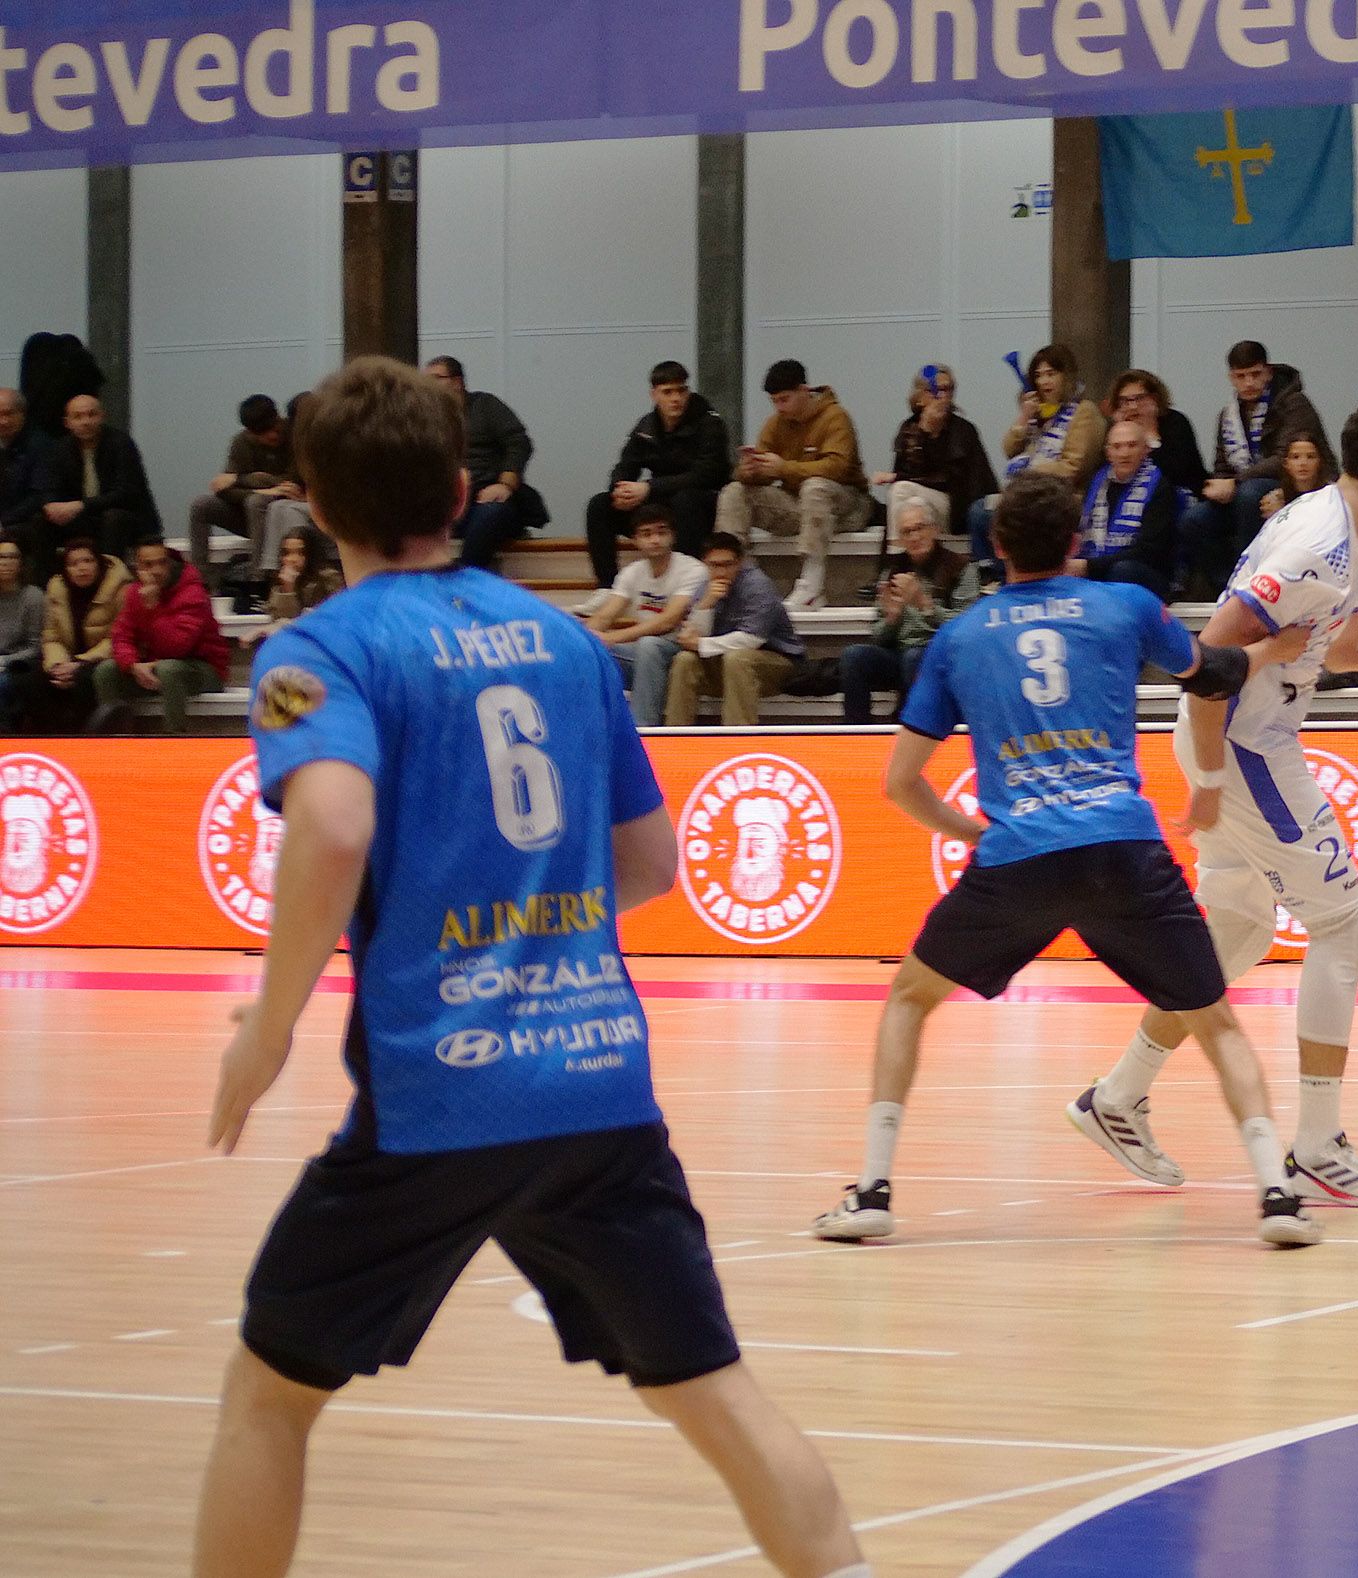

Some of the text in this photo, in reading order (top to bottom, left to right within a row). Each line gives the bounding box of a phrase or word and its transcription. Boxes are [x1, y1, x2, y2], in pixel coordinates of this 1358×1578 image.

[350, 156, 373, 186] C
[1016, 628, 1071, 706] 3
[476, 684, 563, 852] 6
[0, 764, 88, 857] DERETAS
[685, 765, 832, 861] O'PANDERETAS
[1314, 836, 1352, 883] 2
[437, 887, 607, 951] ALIMERK
[700, 881, 821, 932] TABERNA
